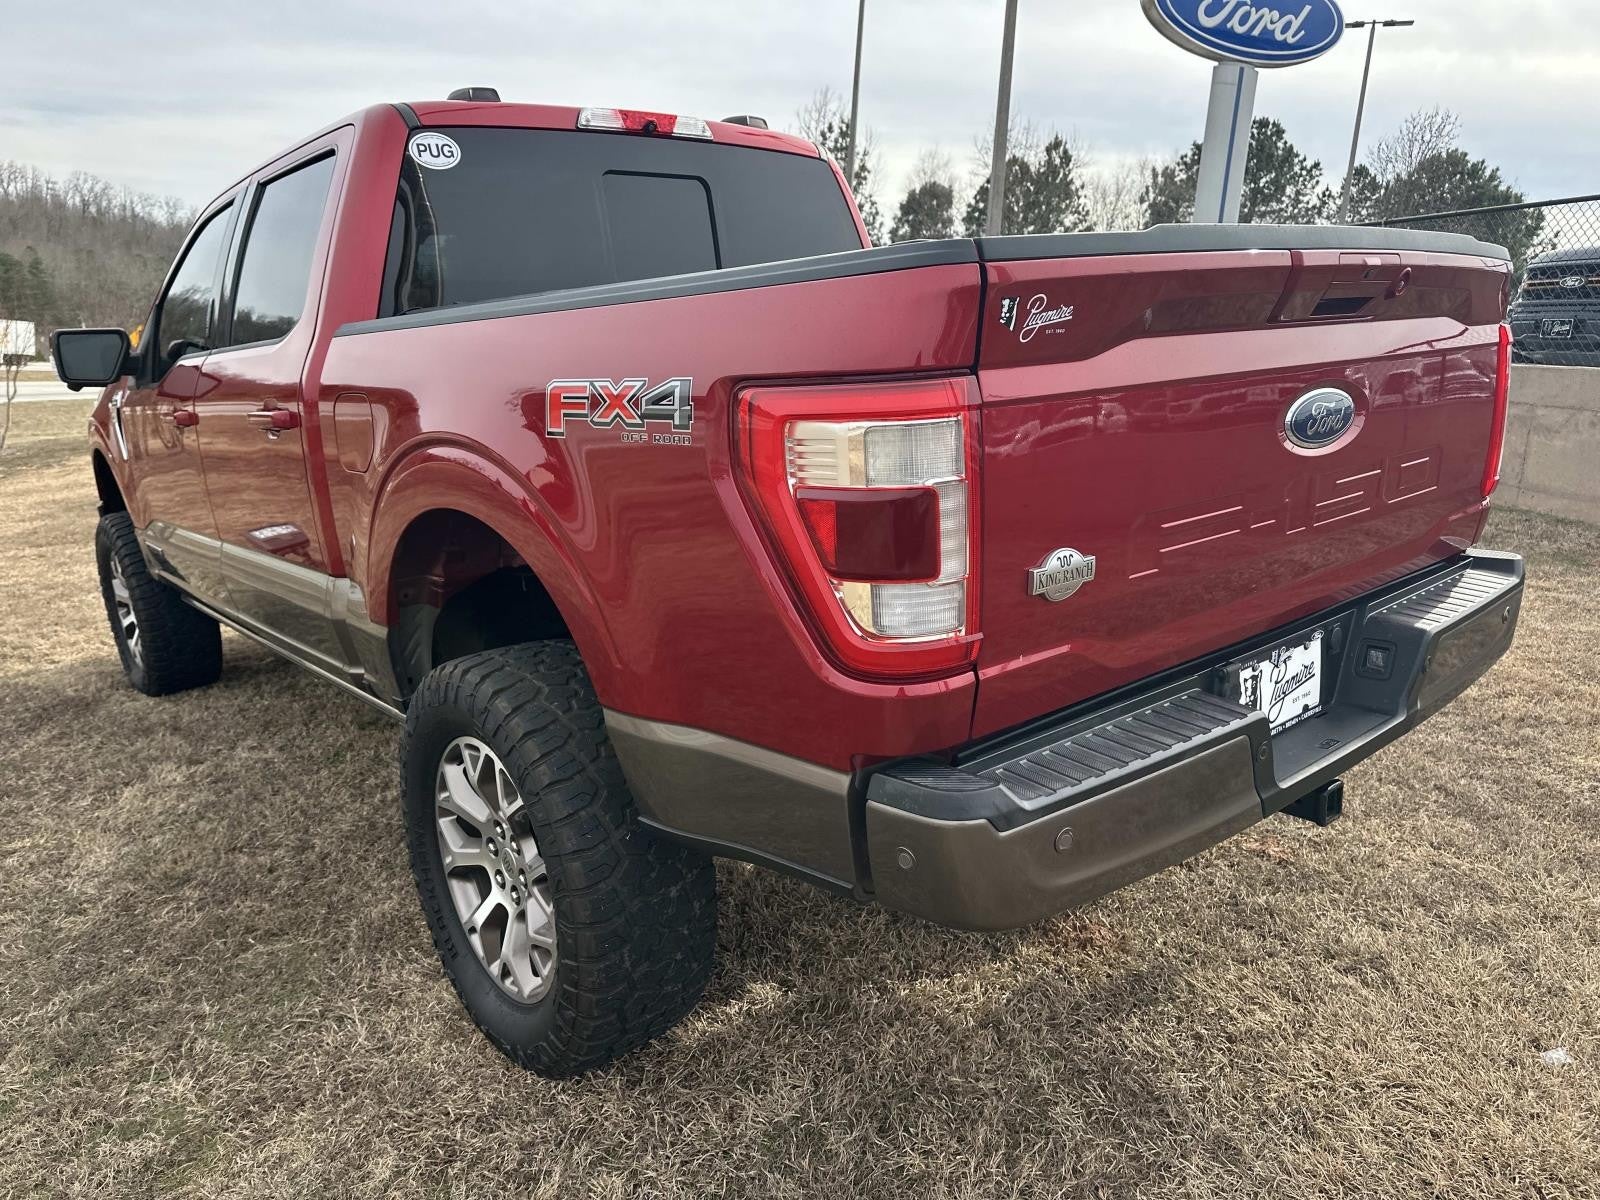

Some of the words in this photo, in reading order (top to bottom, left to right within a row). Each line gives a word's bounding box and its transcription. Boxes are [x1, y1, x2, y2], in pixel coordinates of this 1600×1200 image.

[416, 143, 454, 158] PUG
[1020, 294, 1073, 342] Pugmire
[545, 377, 693, 438] FX4
[1306, 402, 1345, 436] Ford
[621, 433, 648, 443] OFF
[653, 434, 691, 445] ROAD
[1038, 571, 1060, 590] KING
[1063, 561, 1093, 584] RANCH
[1268, 660, 1315, 723] Pugmire
